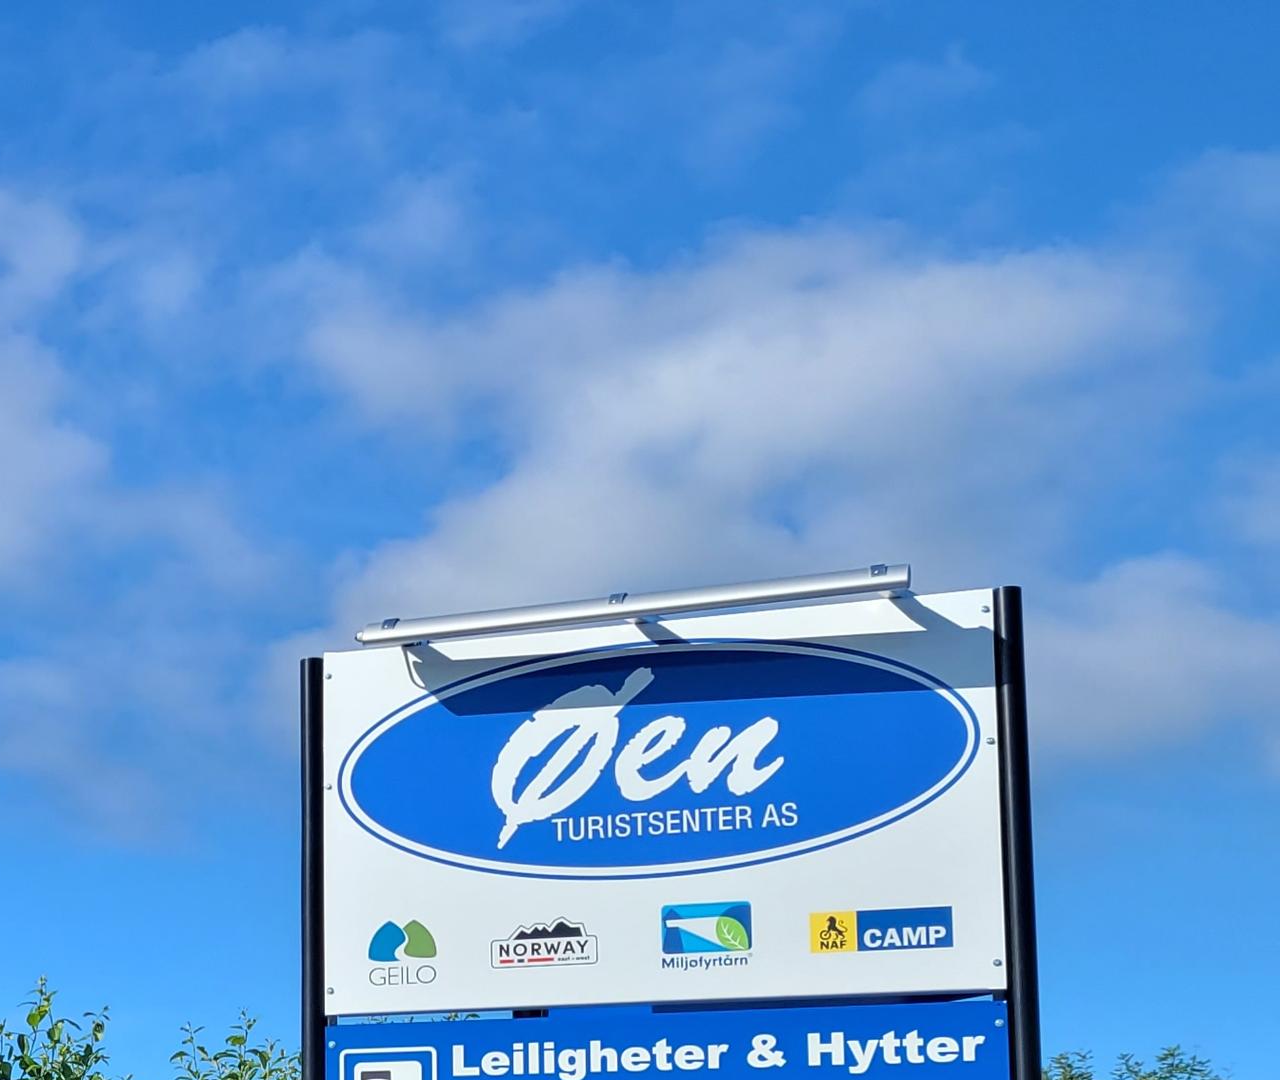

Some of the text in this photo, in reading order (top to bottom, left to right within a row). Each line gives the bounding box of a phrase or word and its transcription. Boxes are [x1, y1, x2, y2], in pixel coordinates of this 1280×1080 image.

[491, 667, 784, 849] Øen
[551, 802, 799, 842] TURISTSENTER AS
[820, 940, 847, 950] NAF
[863, 926, 947, 948] CAMP
[499, 940, 588, 957] NORWAY
[369, 965, 437, 986] GEILO
[747, 1033, 787, 1069] &
[806, 1029, 986, 1074] Hytter
